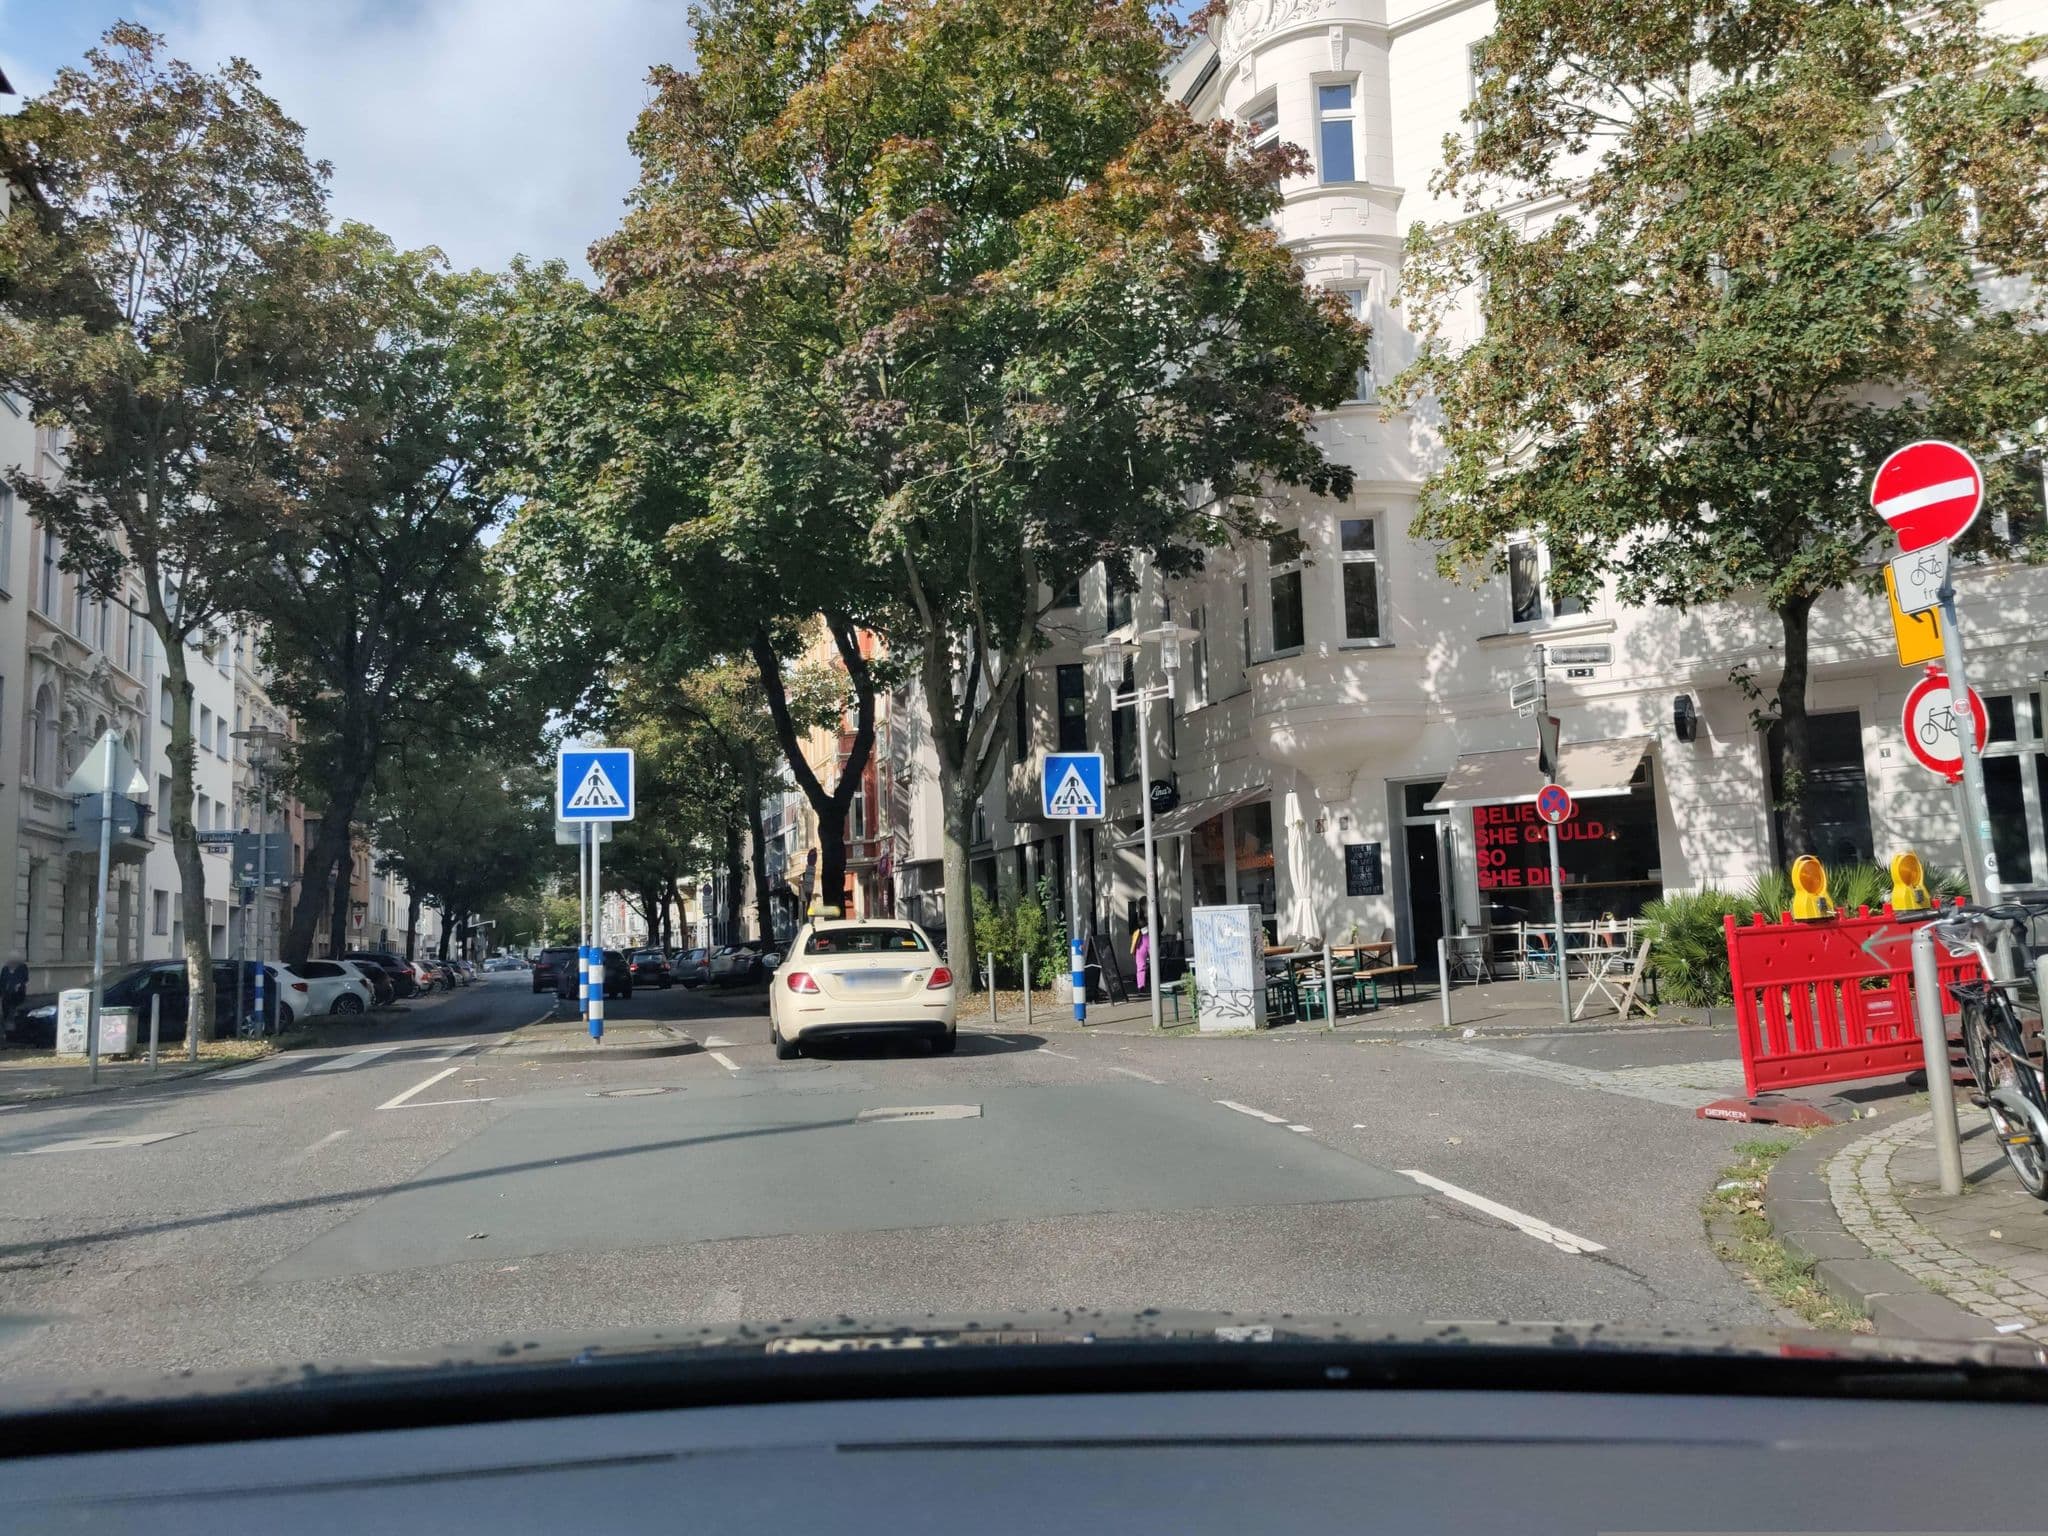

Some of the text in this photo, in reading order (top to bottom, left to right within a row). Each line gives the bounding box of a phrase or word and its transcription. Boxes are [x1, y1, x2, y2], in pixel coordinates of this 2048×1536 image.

[1474, 803, 1579, 825] BELIED
[1476, 826, 1519, 846] SHE
[1477, 848, 1507, 868] SO
[1479, 869, 1522, 889] SHE
